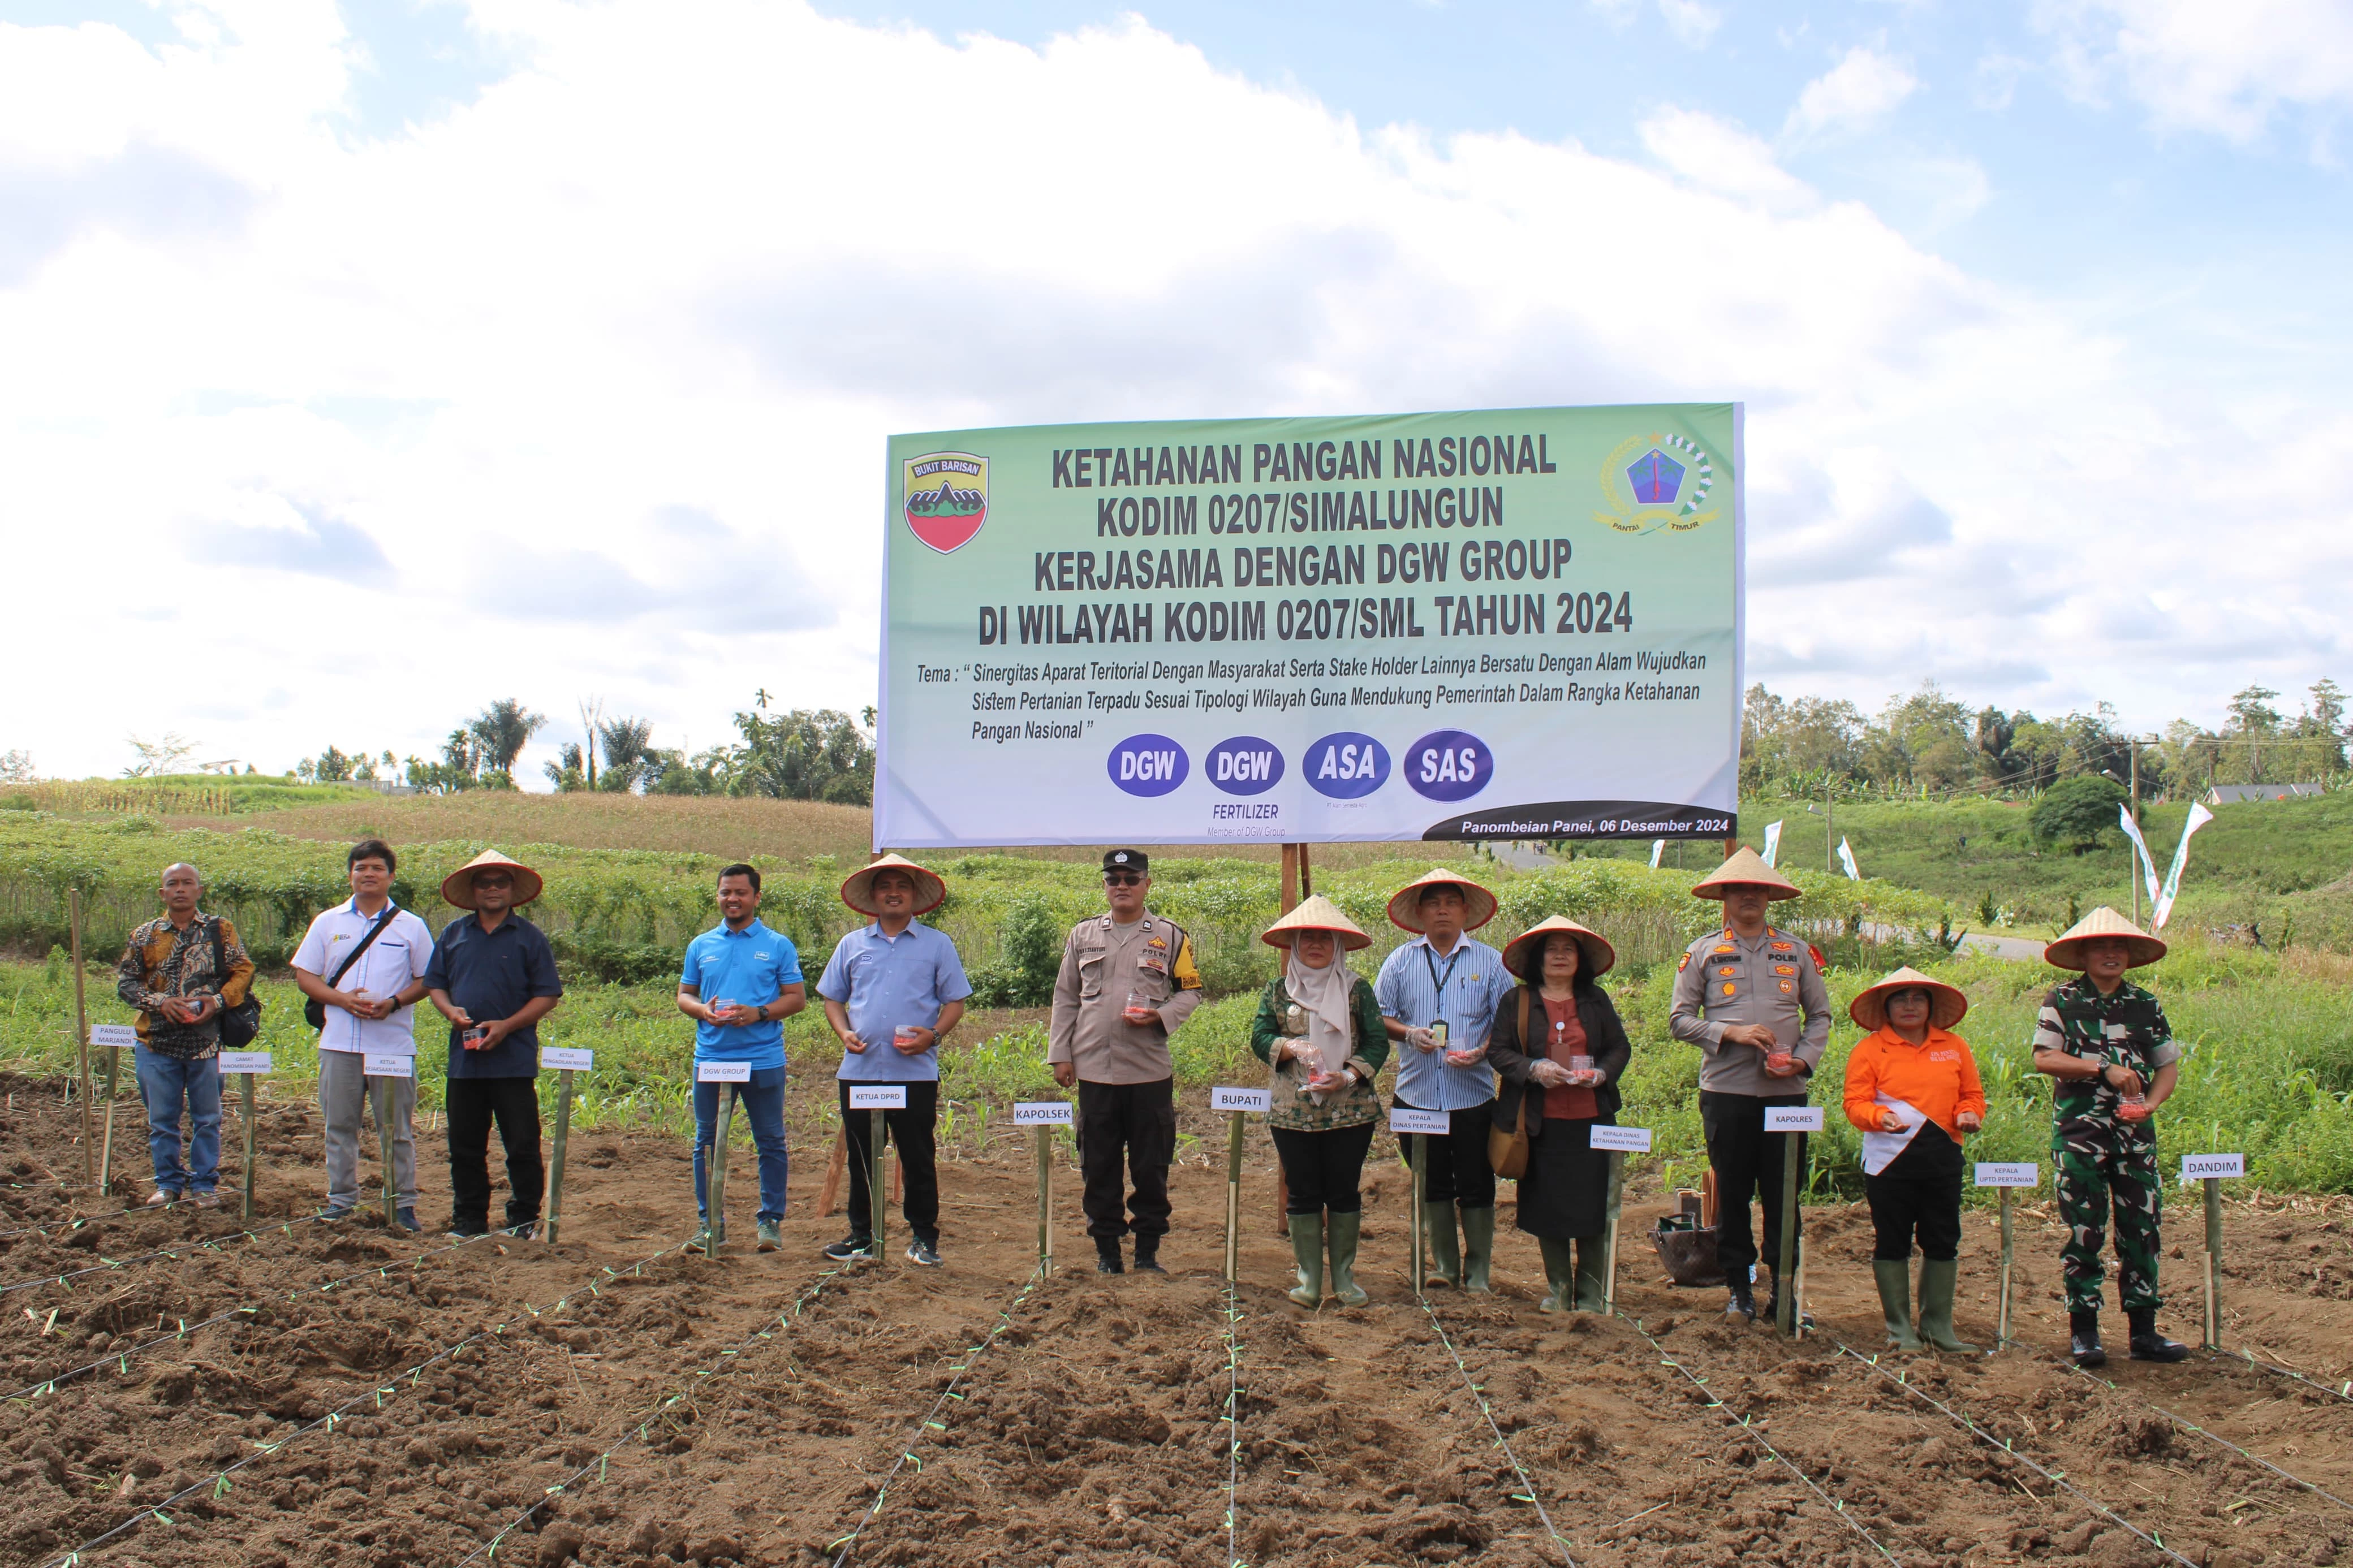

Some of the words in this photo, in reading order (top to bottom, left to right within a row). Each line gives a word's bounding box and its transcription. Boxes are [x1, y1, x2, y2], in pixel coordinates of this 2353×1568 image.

[914, 462, 939, 476] BUKIT
[942, 461, 979, 474] BARISAN
[1053, 444, 1241, 487] KETAHANAN
[1254, 440, 1381, 482] PANGAN
[1394, 434, 1556, 478] NASIONAL
[1098, 496, 1197, 537] KODIM
[1209, 487, 1502, 534] 0207/SIMALUNGUN
[1672, 521, 1699, 530] TIMUR
[1036, 548, 1223, 591] KERJASAMA
[1235, 545, 1364, 586] DENGAN
[1378, 542, 1449, 584] DGW
[1460, 539, 1571, 581] GROUP
[980, 606, 1006, 645] DI
[1018, 603, 1152, 644] WILAYAH
[1165, 601, 1265, 642] KODIM
[1277, 597, 1424, 640] 0207/SML
[1434, 594, 1544, 636] TAHUN
[1557, 591, 1632, 633] 2024
[918, 665, 950, 682] Tema
[973, 663, 1038, 685] Sinergitas
[1042, 663, 1086, 685] Aparat
[1091, 662, 1148, 680] Teritorial
[1153, 661, 1203, 684] Dengan
[1208, 659, 1285, 683] Masyarakat
[1290, 659, 1324, 677] Serta
[1330, 658, 1367, 676] Stake
[1372, 656, 1417, 675] Holder
[1421, 656, 1475, 678] Lainnya
[1481, 655, 1534, 672] Bersatu
[1539, 653, 1592, 676] Dengan
[1596, 653, 1631, 670] Alam
[1637, 651, 1705, 675] Wujudkan
[973, 692, 1015, 710] Sistem
[1020, 692, 1081, 710] Pertanian
[1088, 691, 1140, 713] Terpadu
[1145, 690, 1190, 709] Sesuai
[1195, 689, 1248, 712] Tipologi
[1253, 689, 1305, 711] Wilayah
[1311, 688, 1346, 706] Guna
[1351, 686, 1432, 709] Mendukung
[1437, 684, 1515, 703] Pemerintah
[1520, 684, 1563, 702] Dalam
[1568, 683, 1619, 705] Rangka
[1625, 682, 1699, 700] Ketahanan
[972, 722, 1020, 744] Pangan
[1025, 720, 1082, 738] Nasional
[1121, 751, 1176, 780] DGW
[1217, 751, 1272, 780] DGW
[1318, 745, 1374, 779] ASA
[1421, 748, 1475, 783] SAS
[1213, 805, 1278, 819] FERTILIZER
[1208, 827, 1235, 837] Member
[1237, 826, 1244, 837] of
[1245, 827, 1262, 836] DGW
[1264, 827, 1285, 839] Group
[1462, 821, 1548, 832] Panombeian
[1553, 820, 1594, 833] Panei,
[1600, 820, 1616, 831] 06
[1620, 820, 1692, 831] Desember
[1696, 819, 1728, 831] 2024
[1143, 949, 1166, 958] POLRI
[1768, 953, 1798, 962] POLRI
[1222, 1095, 1261, 1105] BUPATI
[1016, 1109, 1070, 1120] KAPOLSEK
[2188, 1161, 2237, 1173] DANDIM
